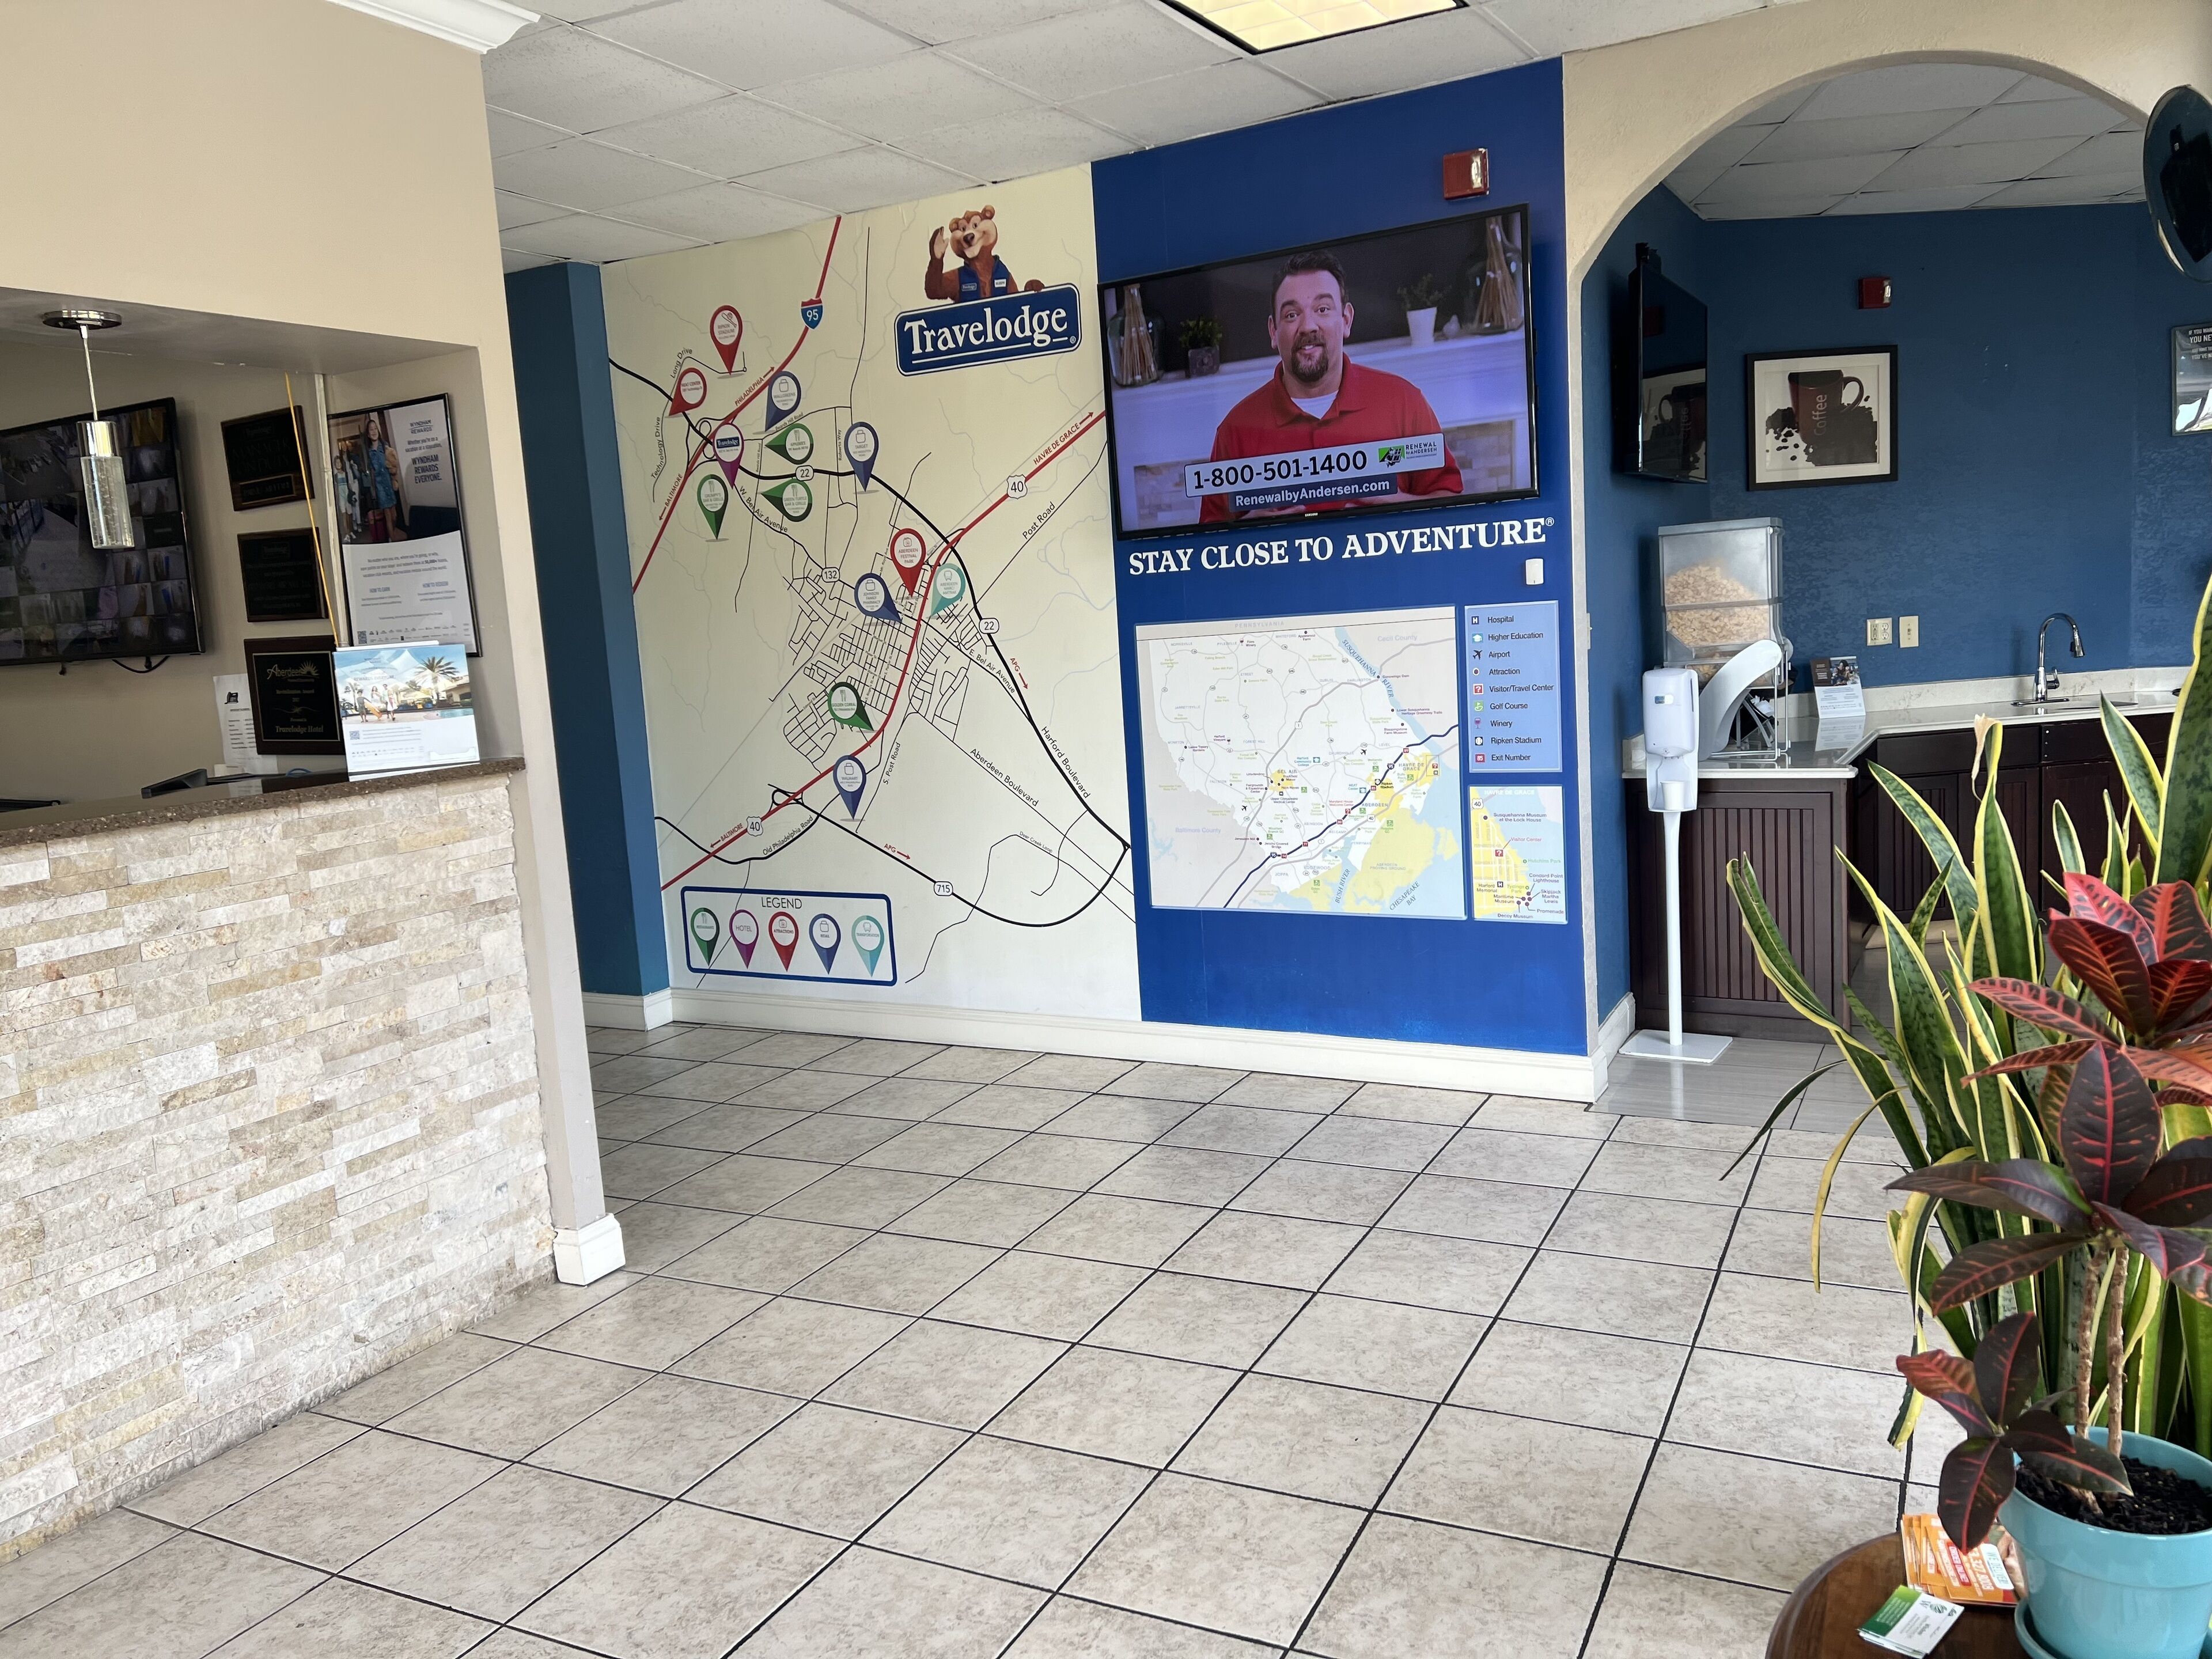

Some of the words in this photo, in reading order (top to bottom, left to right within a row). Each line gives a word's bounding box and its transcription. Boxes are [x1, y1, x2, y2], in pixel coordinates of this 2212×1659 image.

[806, 309, 819, 323] 95
[904, 305, 1067, 354] Travelodge
[2190, 335, 2202, 343] YOU
[670, 361, 682, 378] Long
[677, 347, 693, 359] Drive
[734, 377, 764, 406] PHILADELPHIA
[1032, 445, 1052, 465] HAVRE
[1052, 439, 1061, 450] DE
[1059, 423, 1081, 445] GRACE
[1406, 441, 1437, 450] RENEWAL
[411, 454, 439, 465] WYNDHAM
[651, 437, 664, 479] Technology
[415, 464, 438, 474] REWARDS
[800, 469, 809, 478] 22
[1194, 450, 1367, 490] 1-800-501-1400
[415, 473, 442, 484] EVERYONE.
[665, 474, 683, 506] BALTIMORE
[1010, 480, 1024, 494] 40
[1236, 480, 1389, 506] RenewalbyAndersen.com
[755, 509, 764, 519] Air
[764, 516, 788, 533] Avenue
[1022, 522, 1039, 540] Post
[1036, 501, 1055, 523] Road
[1128, 547, 1196, 576] STAY
[1200, 540, 1288, 570] CLOSE
[1294, 536, 1334, 562] TO
[824, 570, 838, 579] 132
[983, 622, 995, 631] 22
[1487, 616, 1514, 624] Hospital
[1488, 634, 1509, 642] Higher
[1488, 651, 1510, 659] Airport
[969, 649, 975, 657] E.
[976, 653, 987, 666] Bel
[987, 662, 996, 672] Air
[995, 668, 1016, 694] Avenue
[1010, 657, 1021, 673] APG
[1342, 639, 1377, 677] SUSQUEHANNA
[1382, 679, 1394, 698] RIVER
[275, 726, 306, 734] Travelodge
[1491, 737, 1513, 745] Ripken
[886, 762, 895, 777] Post
[891, 742, 901, 762] Road
[1041, 726, 1064, 759] Harford
[1062, 757, 1090, 800] Boulevard
[970, 748, 1005, 781] Aberdeen
[1003, 775, 1039, 808] Boulevard
[720, 823, 743, 842] BALTIMORE
[749, 821, 760, 832] 40
[763, 847, 773, 856] Old
[771, 827, 801, 851] Philadelphia
[798, 815, 813, 831] Road
[884, 843, 896, 854] APG
[1030, 838, 1041, 846] Creek
[1043, 844, 1052, 853] Loop
[937, 882, 950, 893] 715
[1335, 885, 1344, 904] BUSH
[1340, 869, 1350, 886] RIVER
[762, 897, 802, 909] LEGEND
[1389, 881, 1420, 911] CHESAPEAKE
[1406, 894, 1417, 906] BAY
